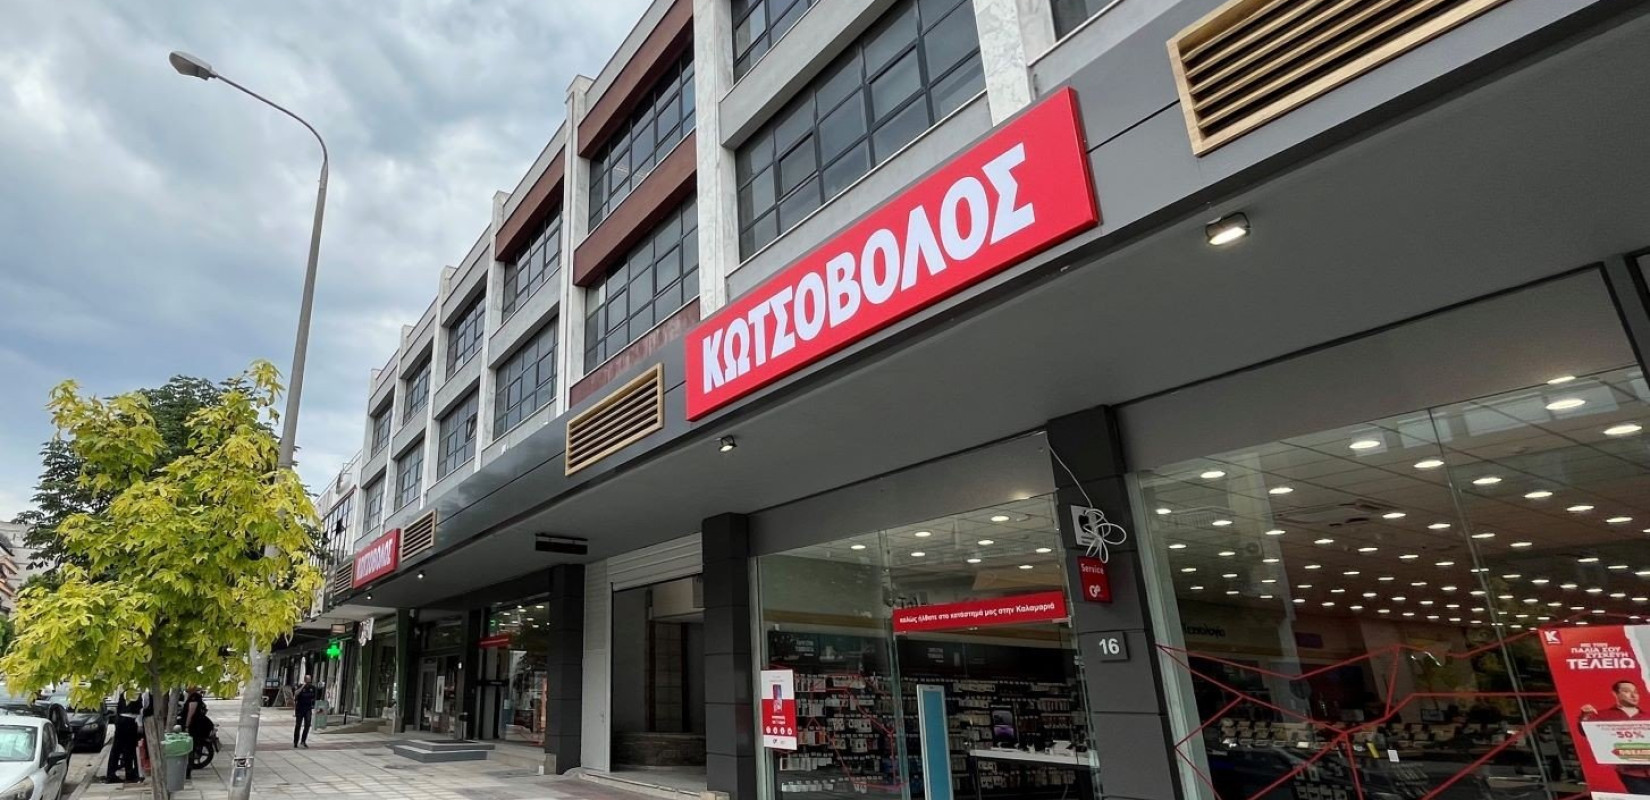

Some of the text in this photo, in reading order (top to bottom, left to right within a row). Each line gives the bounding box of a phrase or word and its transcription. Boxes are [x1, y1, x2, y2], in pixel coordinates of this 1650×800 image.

[703, 143, 1035, 394] ΚΩΤΣΟΒΟΛΟΣ
[1081, 563, 1104, 575] Service
[1016, 602, 1055, 613] Καλαμαριά
[1099, 638, 1120, 655] 16
[1566, 658, 1635, 669] ΤΕΛΕΙΩ
